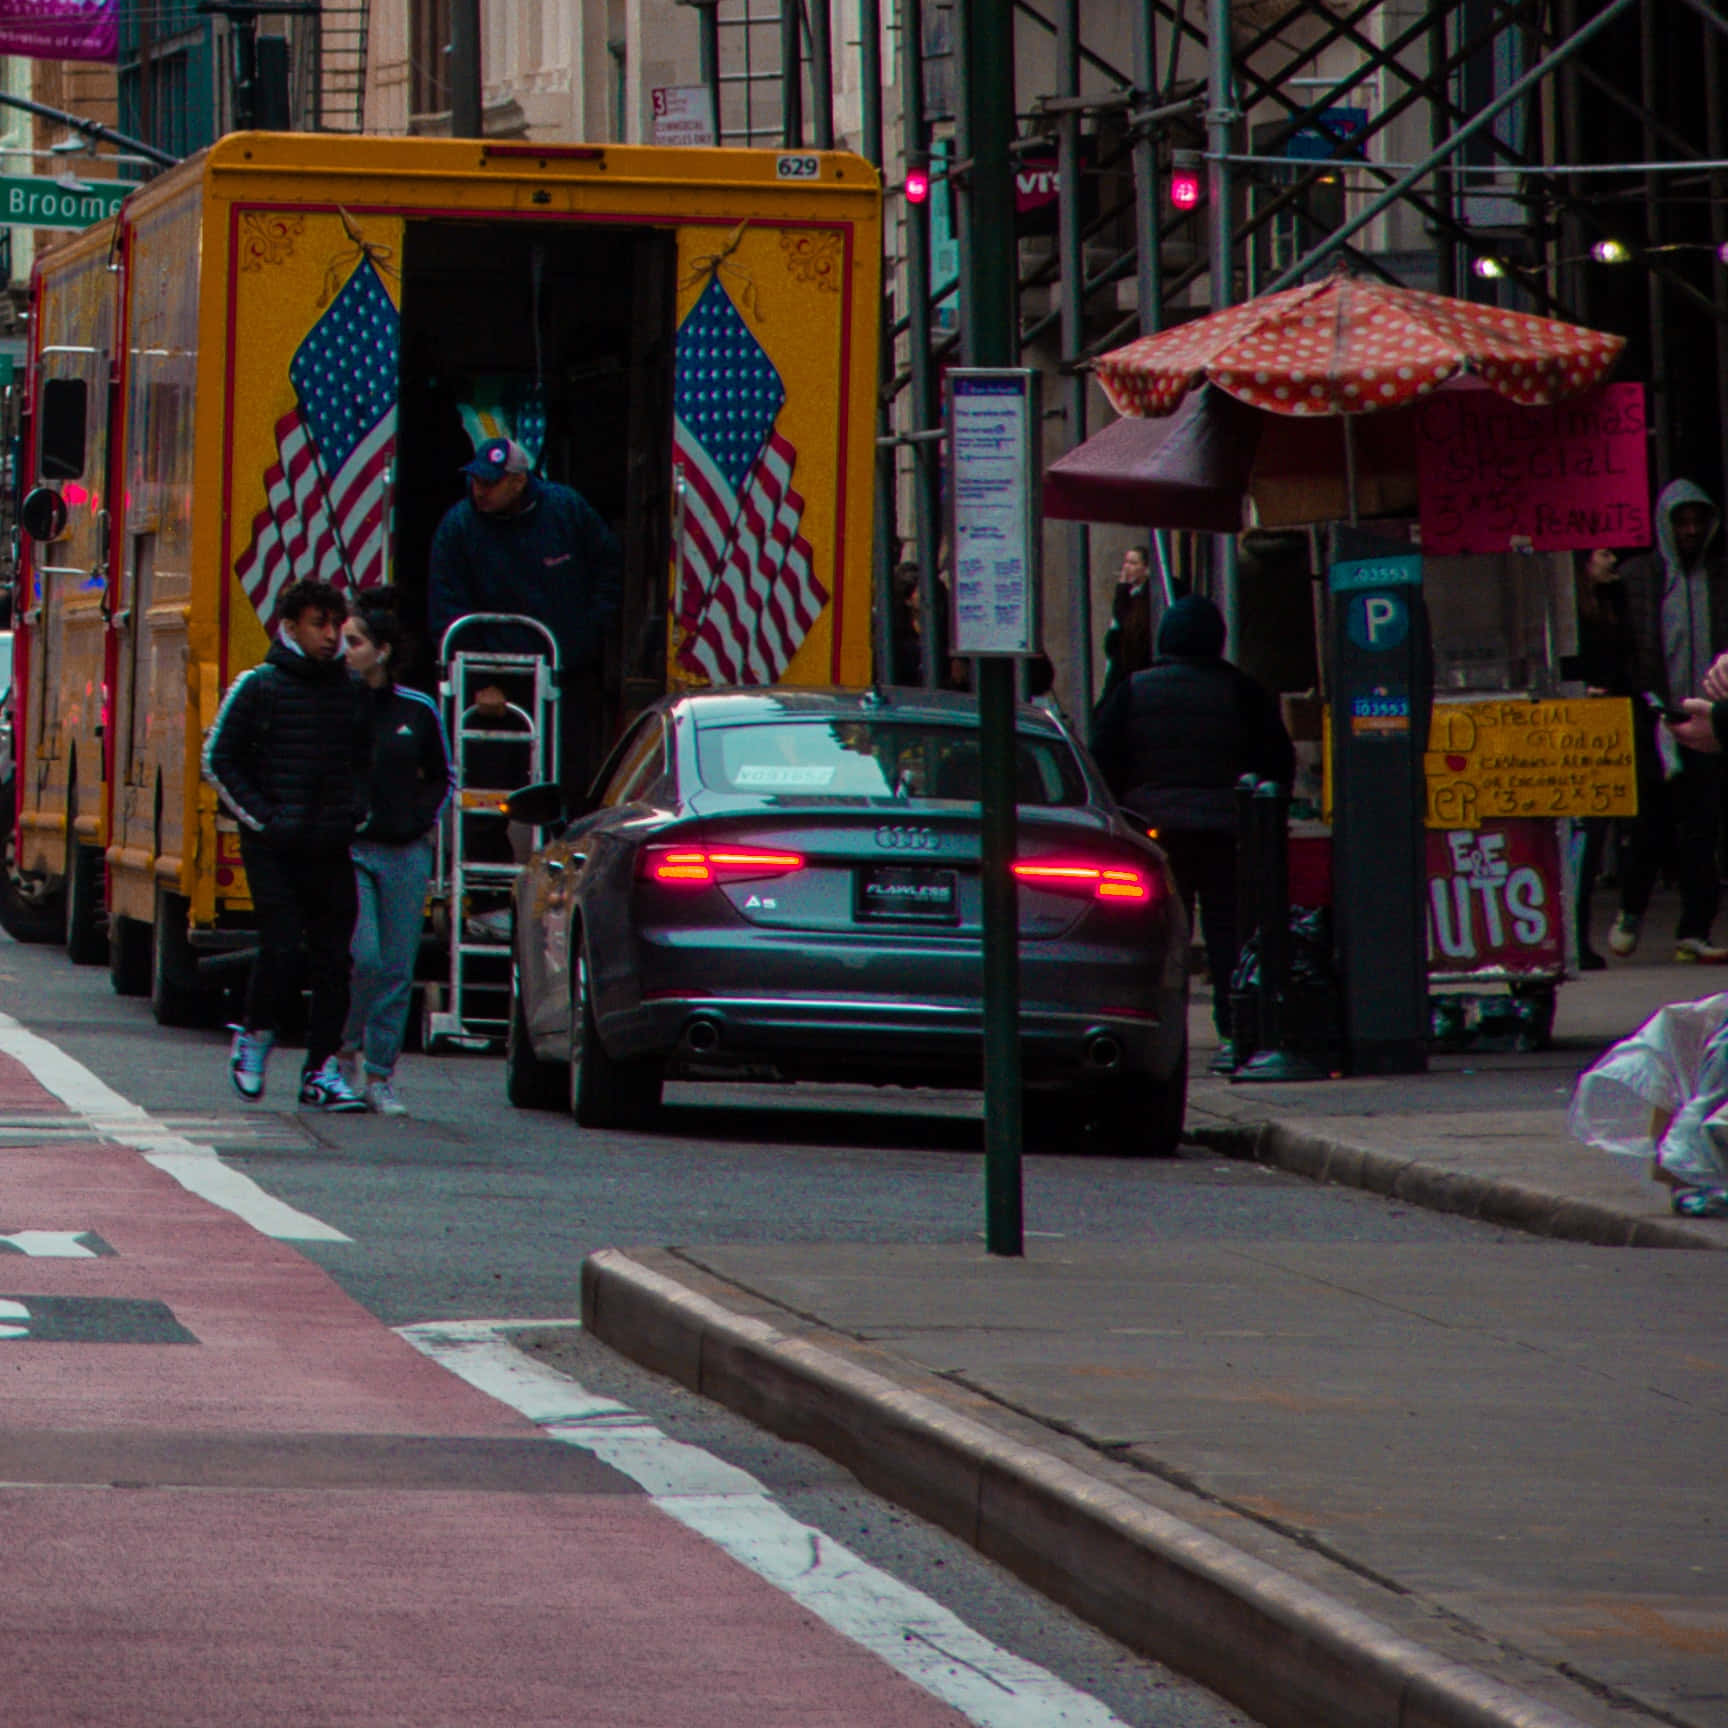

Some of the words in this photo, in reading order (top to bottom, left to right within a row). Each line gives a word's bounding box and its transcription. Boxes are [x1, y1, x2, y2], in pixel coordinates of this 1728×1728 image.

[777, 157, 819, 176] 629
[7, 187, 122, 218] Broome
[1364, 597, 1395, 644] P
[744, 894, 777, 910] A5
[865, 882, 952, 902] FLAWLESS
[1426, 865, 1548, 960] UTS
